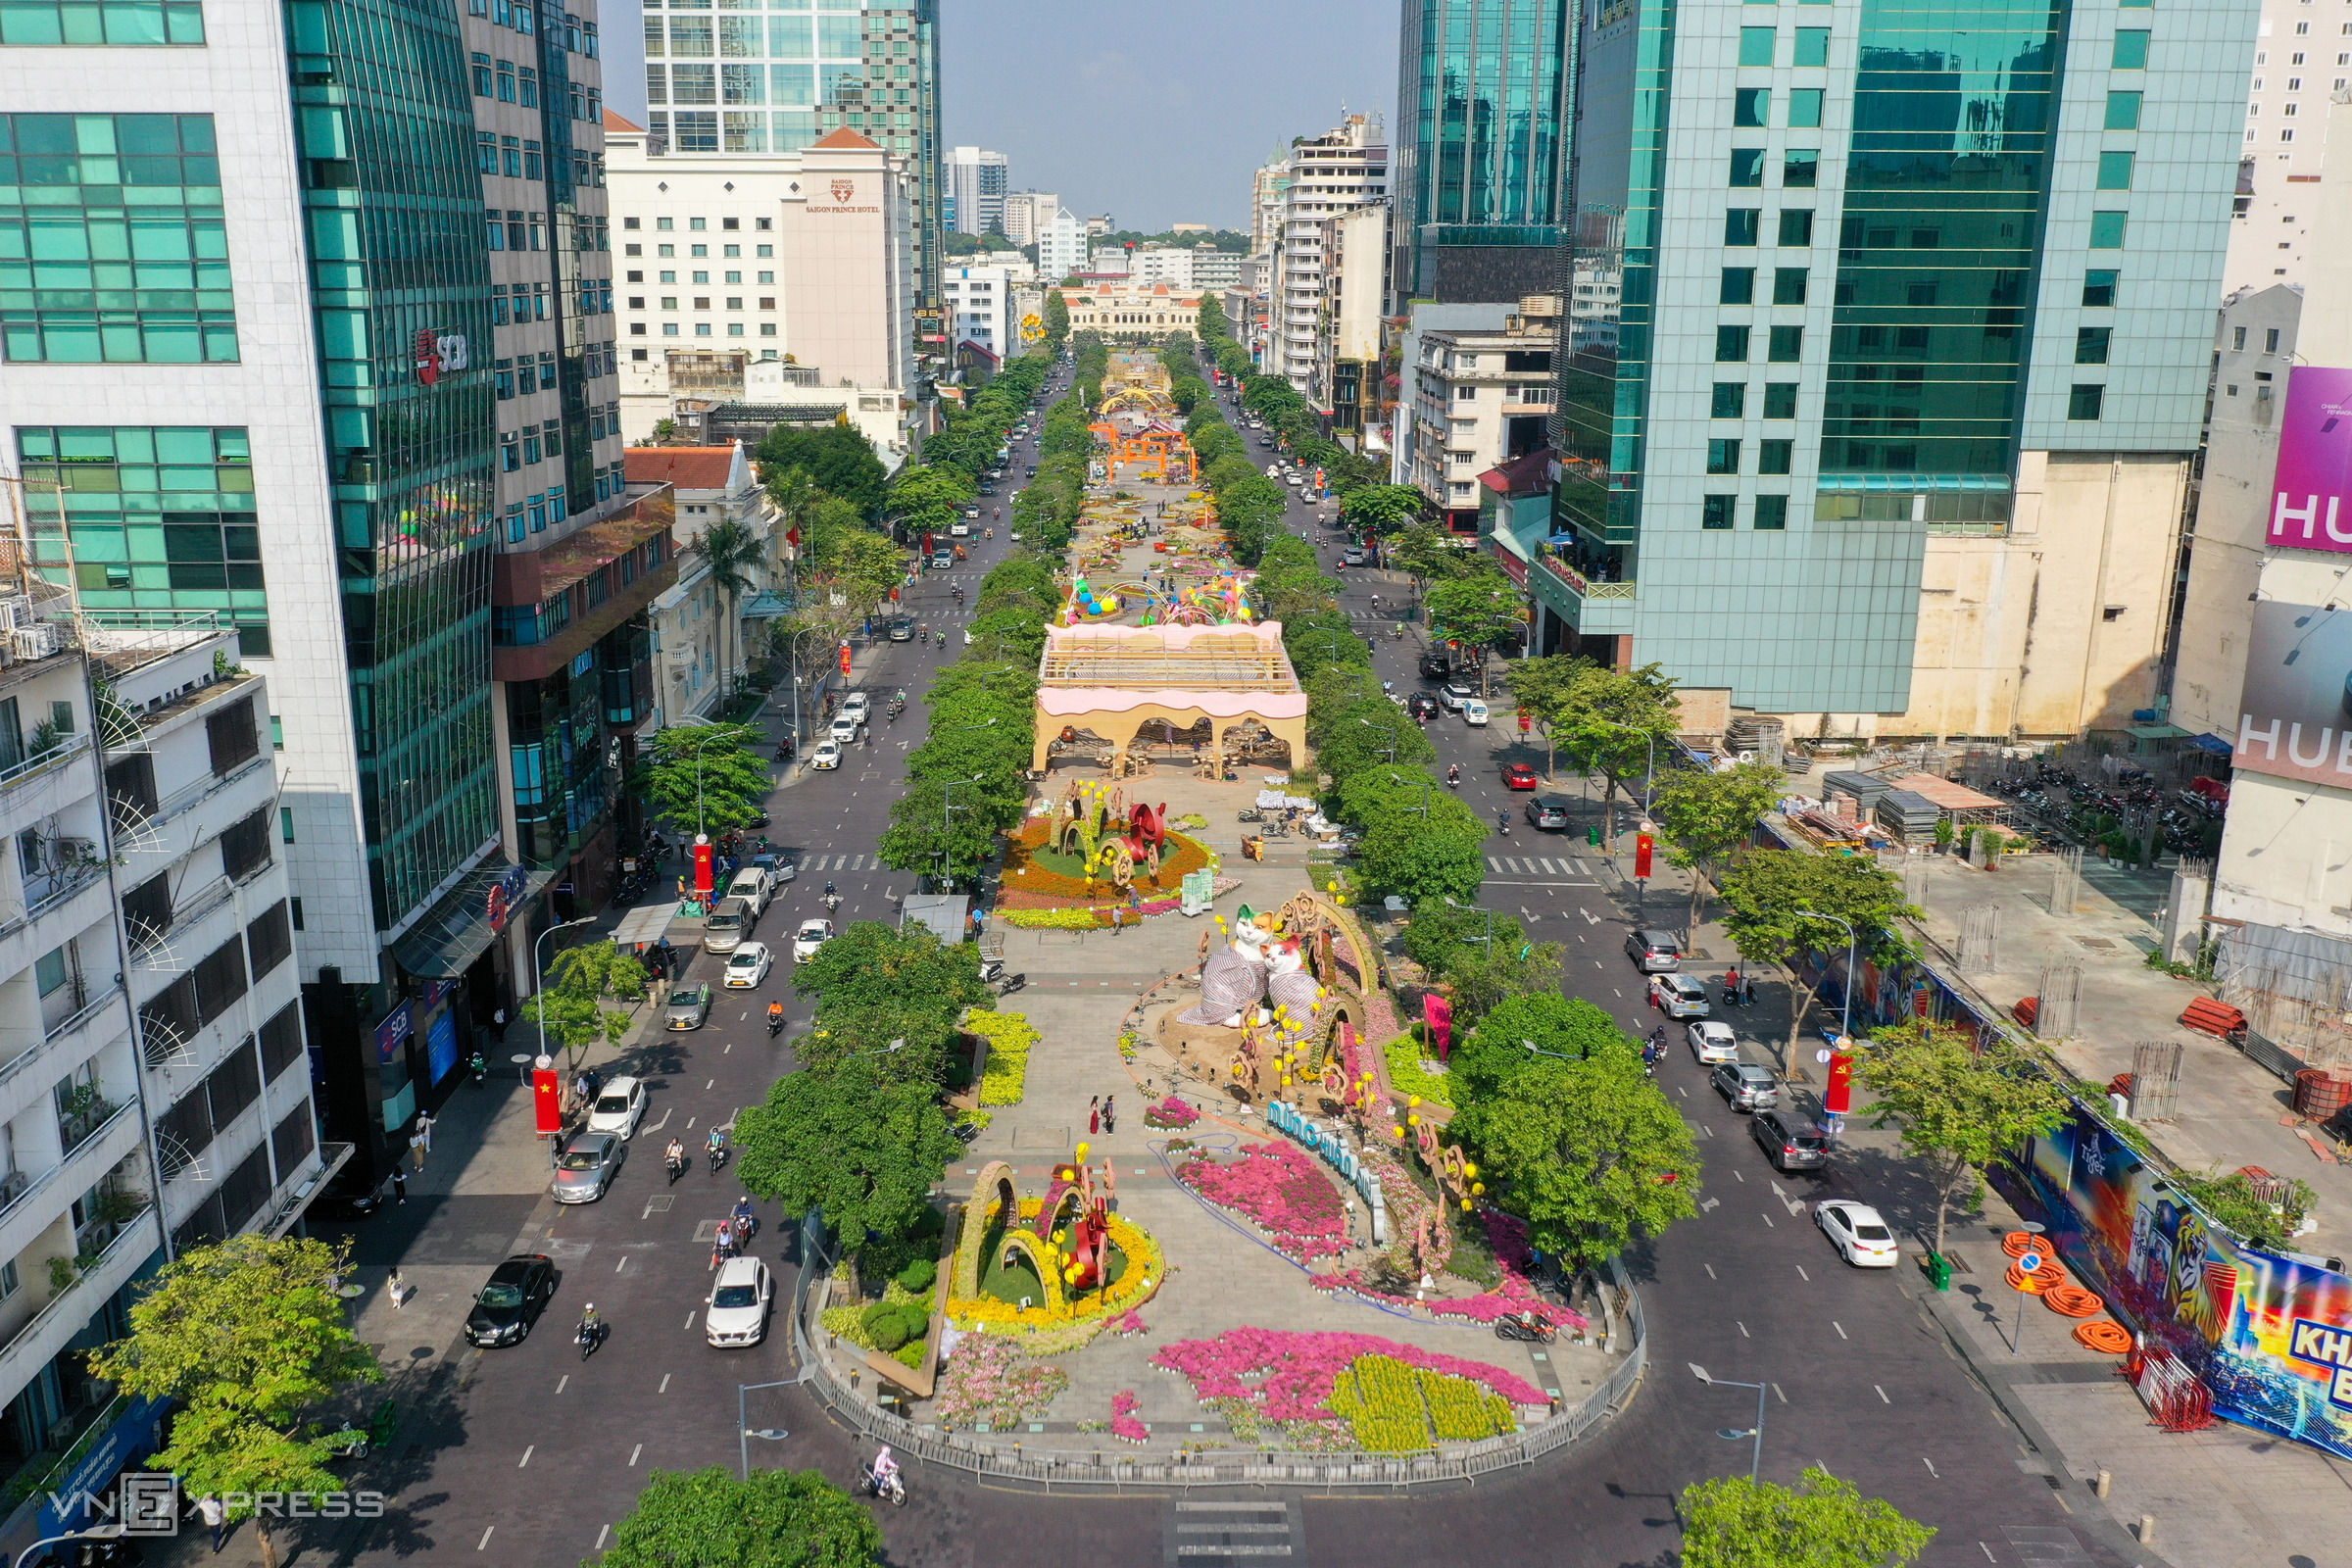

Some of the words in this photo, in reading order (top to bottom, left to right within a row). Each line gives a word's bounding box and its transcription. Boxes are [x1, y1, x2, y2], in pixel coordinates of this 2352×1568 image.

[437, 334, 467, 372] SCB
[391, 1010, 408, 1038] SCB
[2081, 1143, 2106, 1177] Tiger
[2293, 1323, 2352, 1368] KH
